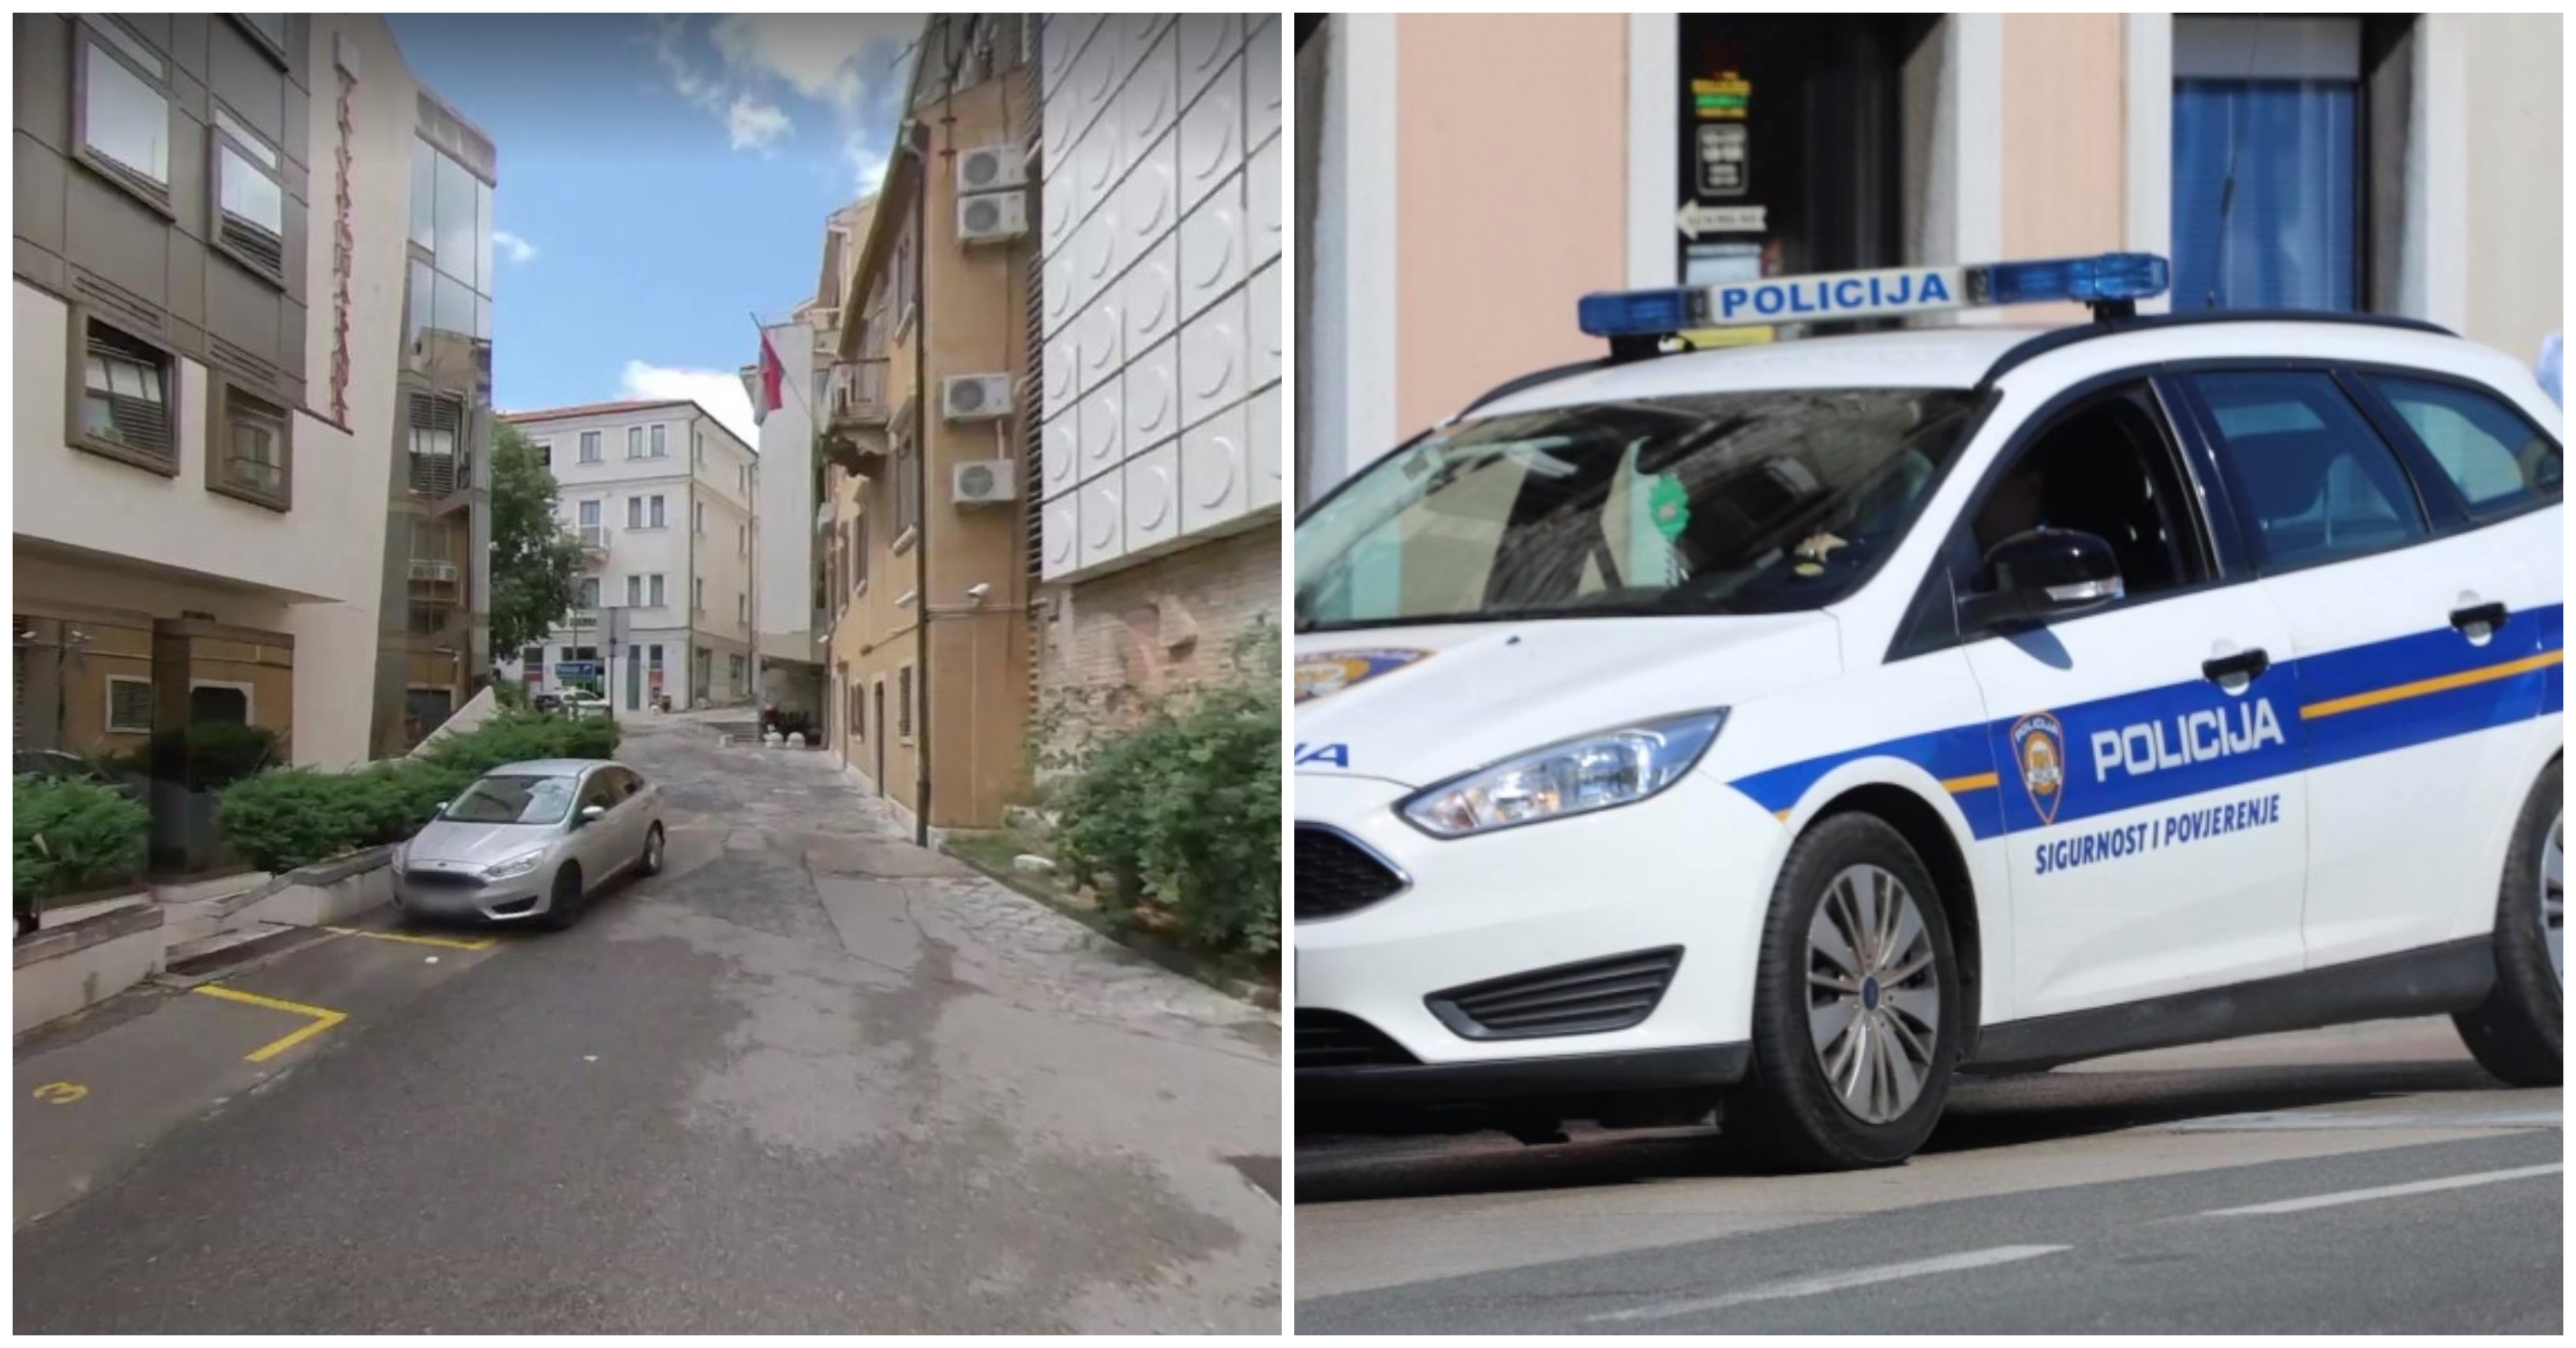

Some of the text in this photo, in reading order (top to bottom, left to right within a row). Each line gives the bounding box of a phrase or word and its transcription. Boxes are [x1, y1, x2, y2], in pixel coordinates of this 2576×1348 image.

[1721, 272, 1949, 316] POLICIJA
[2093, 698, 2283, 781] POLICIJA
[2035, 795, 2280, 874] SIGURNOST I POVJERENJE
